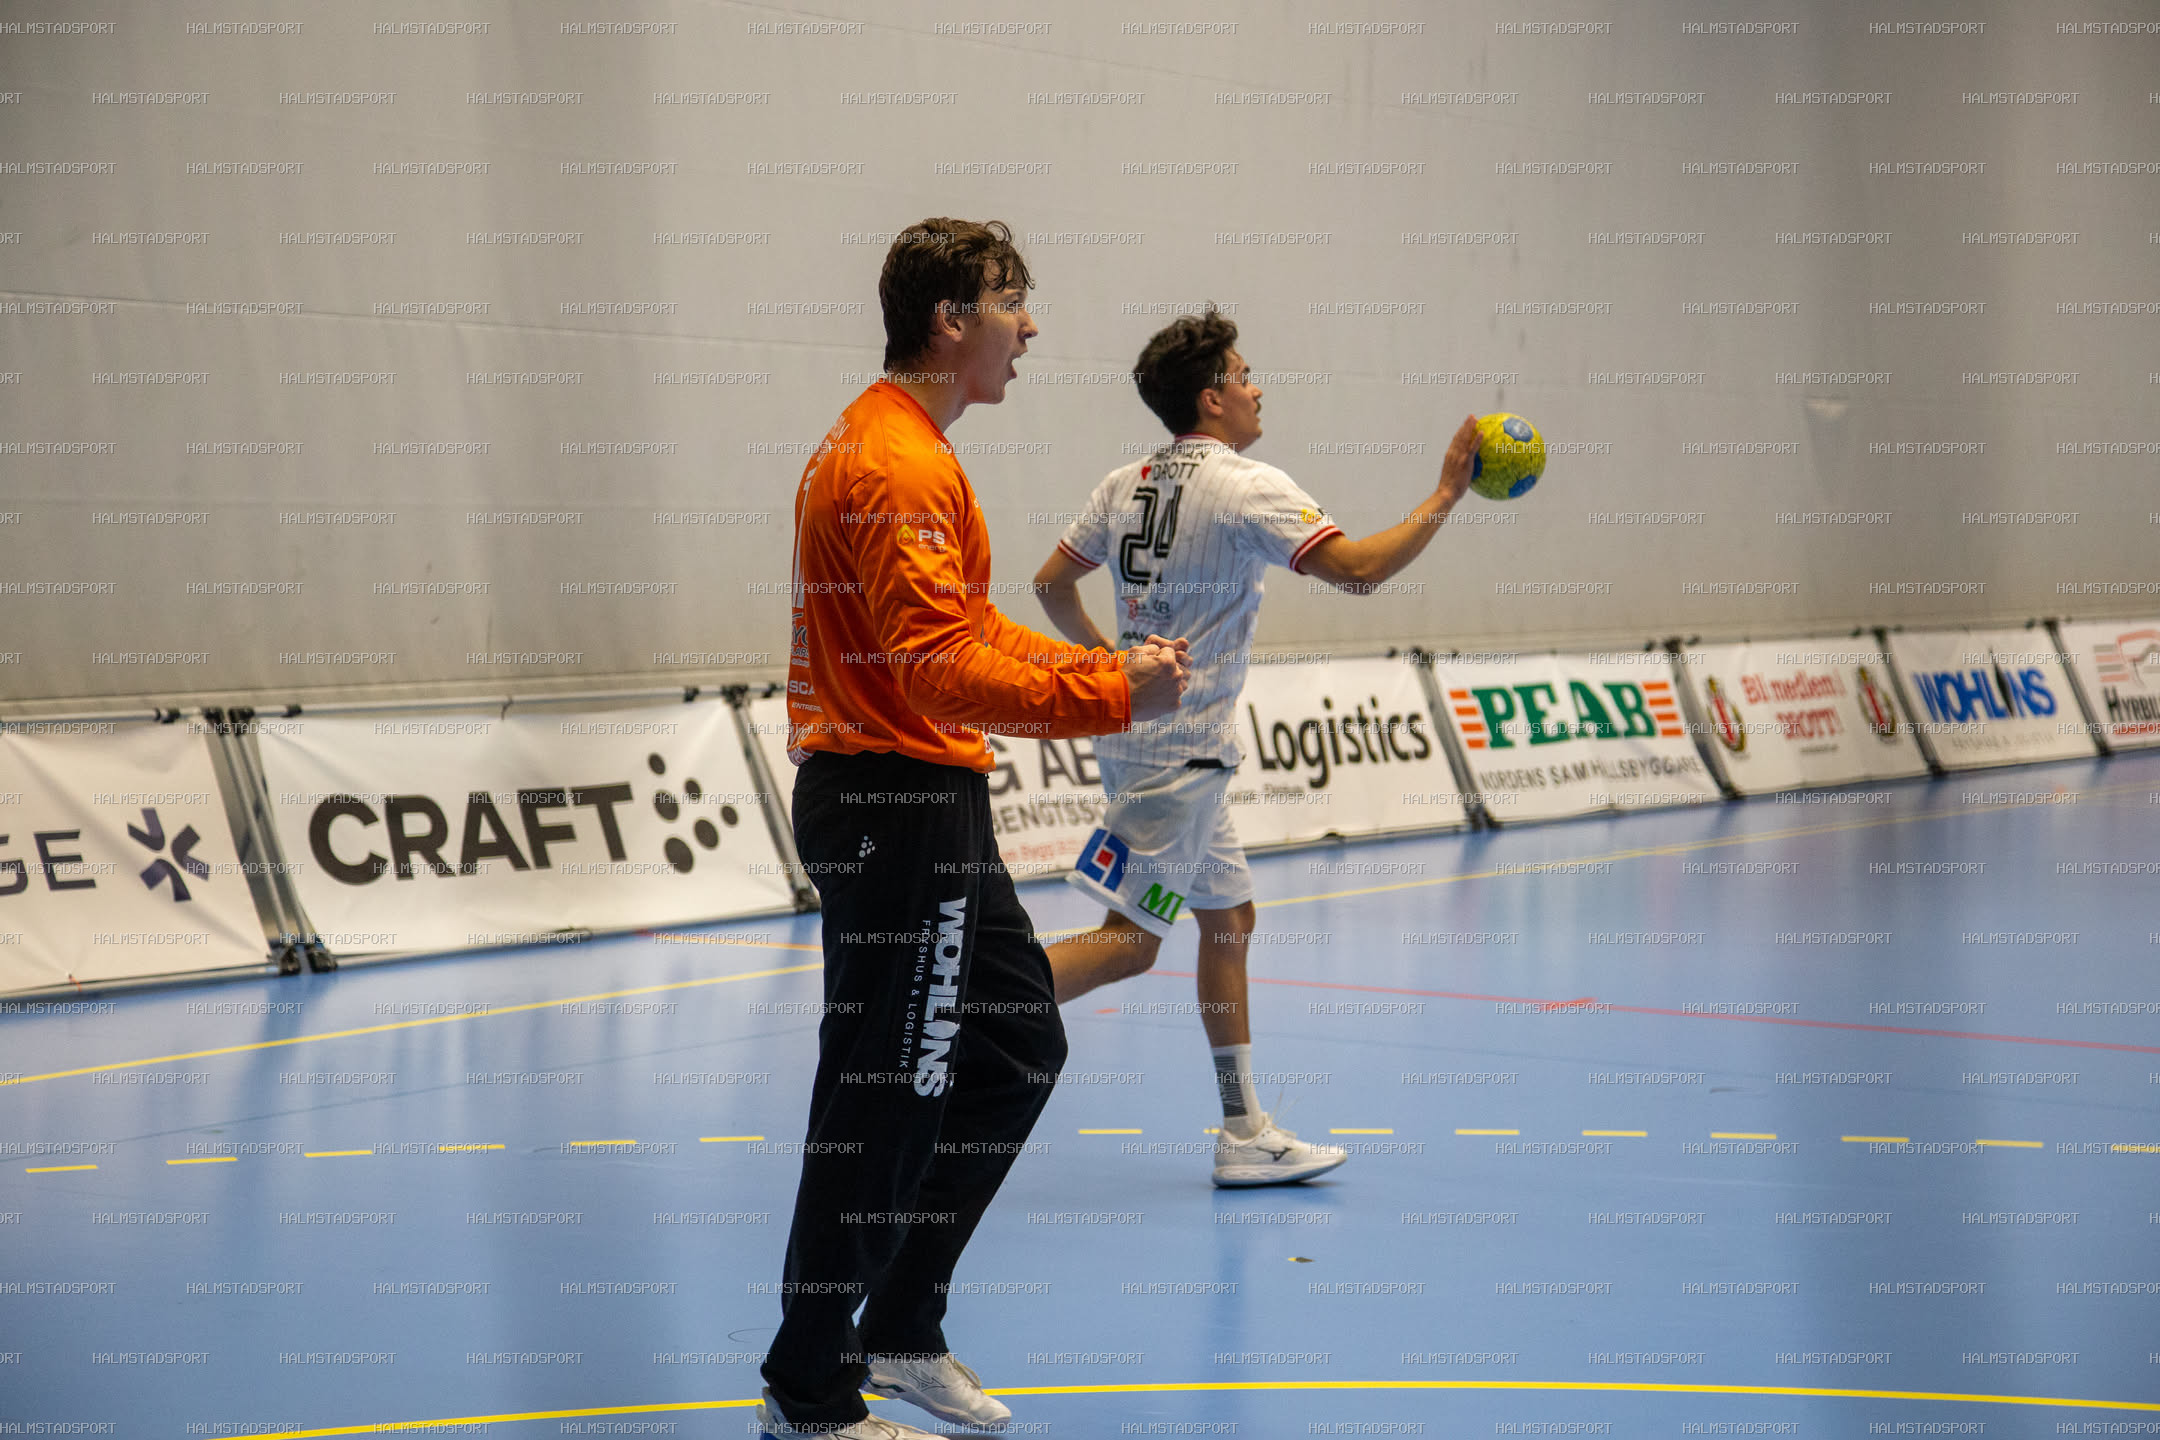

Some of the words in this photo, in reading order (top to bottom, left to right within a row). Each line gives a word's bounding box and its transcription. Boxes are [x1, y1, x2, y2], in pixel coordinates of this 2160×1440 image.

[918, 529, 945, 545] PS
[1247, 695, 1430, 789] Logistics
[1473, 680, 1656, 749] PEAB
[1480, 768, 1546, 791] NORDENS
[309, 780, 633, 886] CRAFT
[899, 1003, 918, 1069] LOGISTIK
